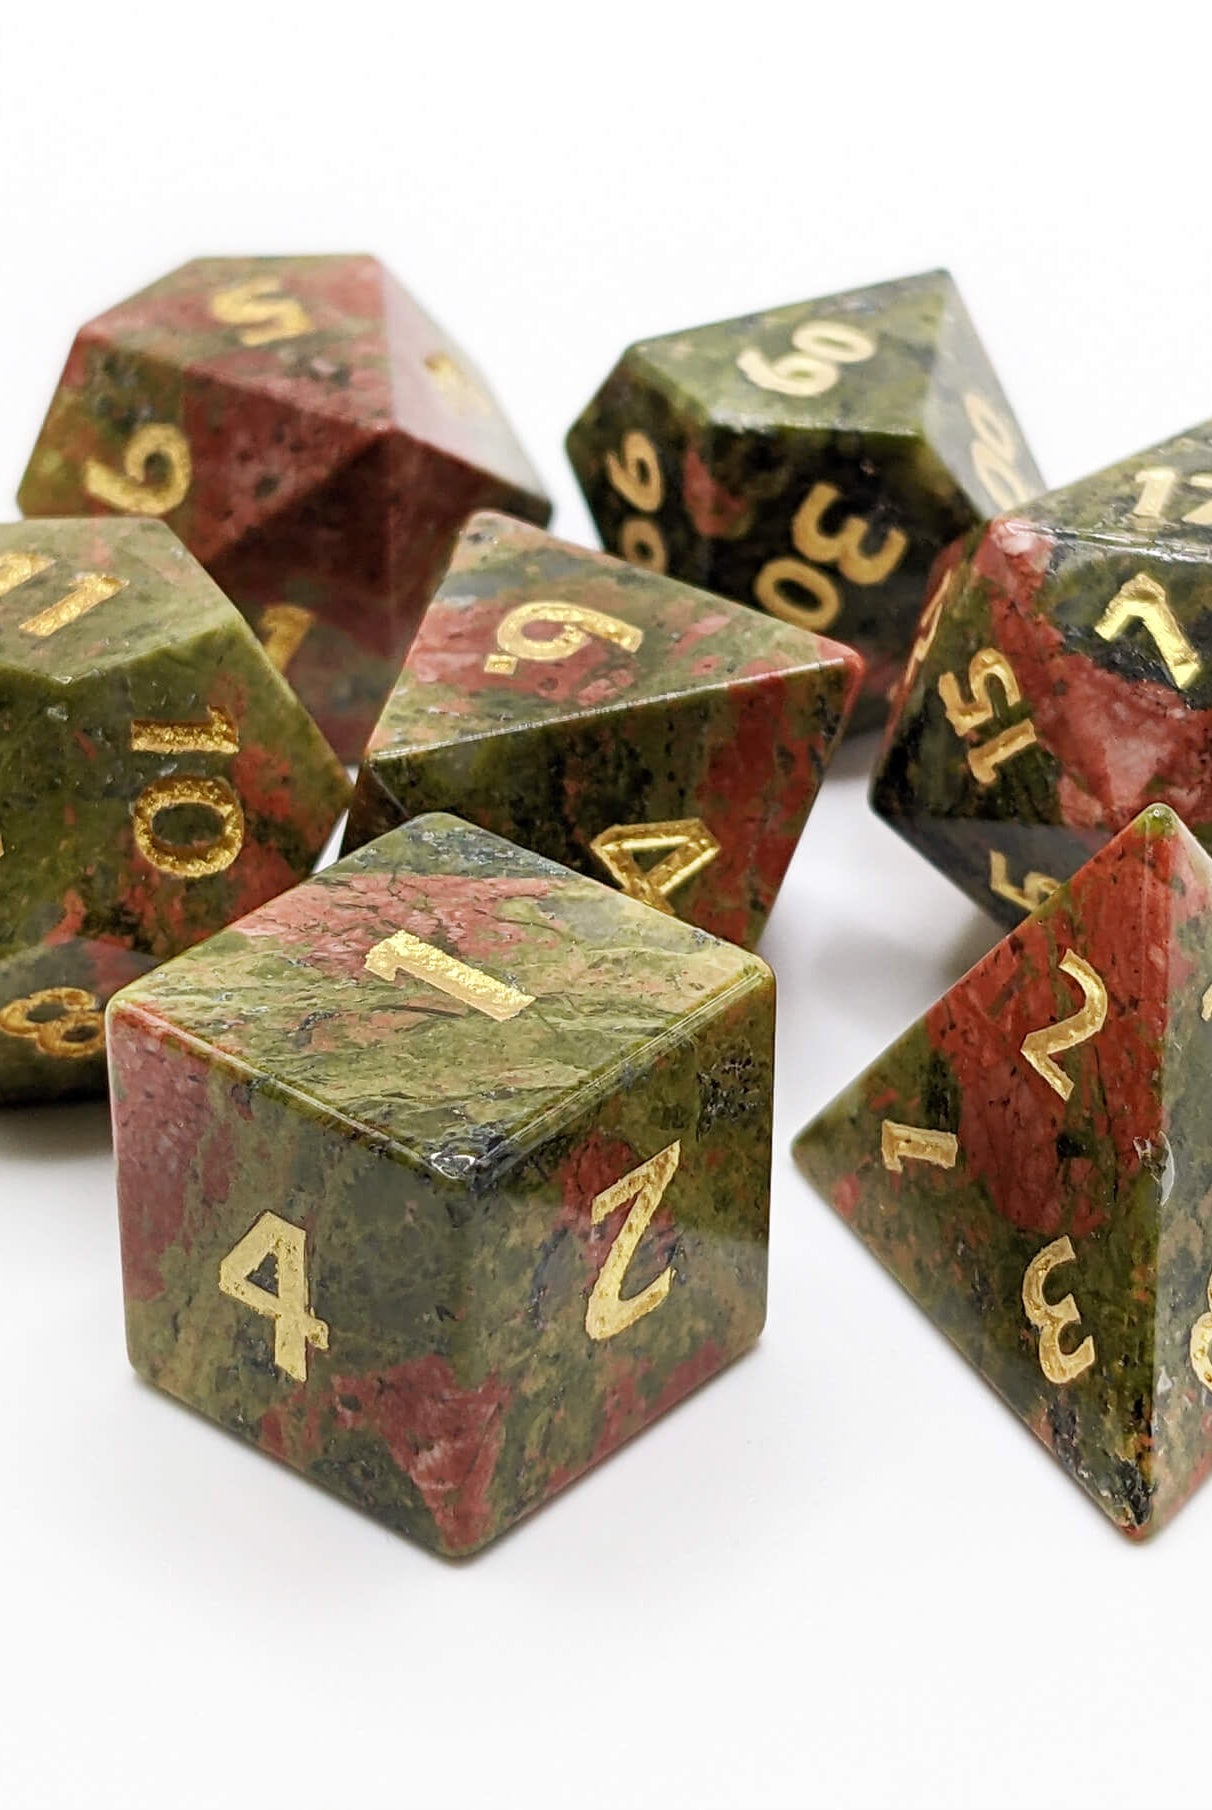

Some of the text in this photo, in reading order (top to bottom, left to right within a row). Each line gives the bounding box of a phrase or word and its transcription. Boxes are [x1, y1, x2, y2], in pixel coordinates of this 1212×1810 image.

[211, 278, 314, 346] 5
[735, 321, 877, 396] 60
[753, 483, 908, 632] 30
[1094, 572, 1201, 690] 7
[938, 647, 1038, 784] 15
[130, 704, 246, 878] 10
[591, 817, 721, 916] 4
[364, 929, 536, 1022] 1
[1020, 948, 1107, 1100] 2
[882, 1119, 958, 1170] 1
[218, 1209, 329, 1382] 4
[585, 1140, 680, 1340] 2
[1022, 1235, 1095, 1384] 3
